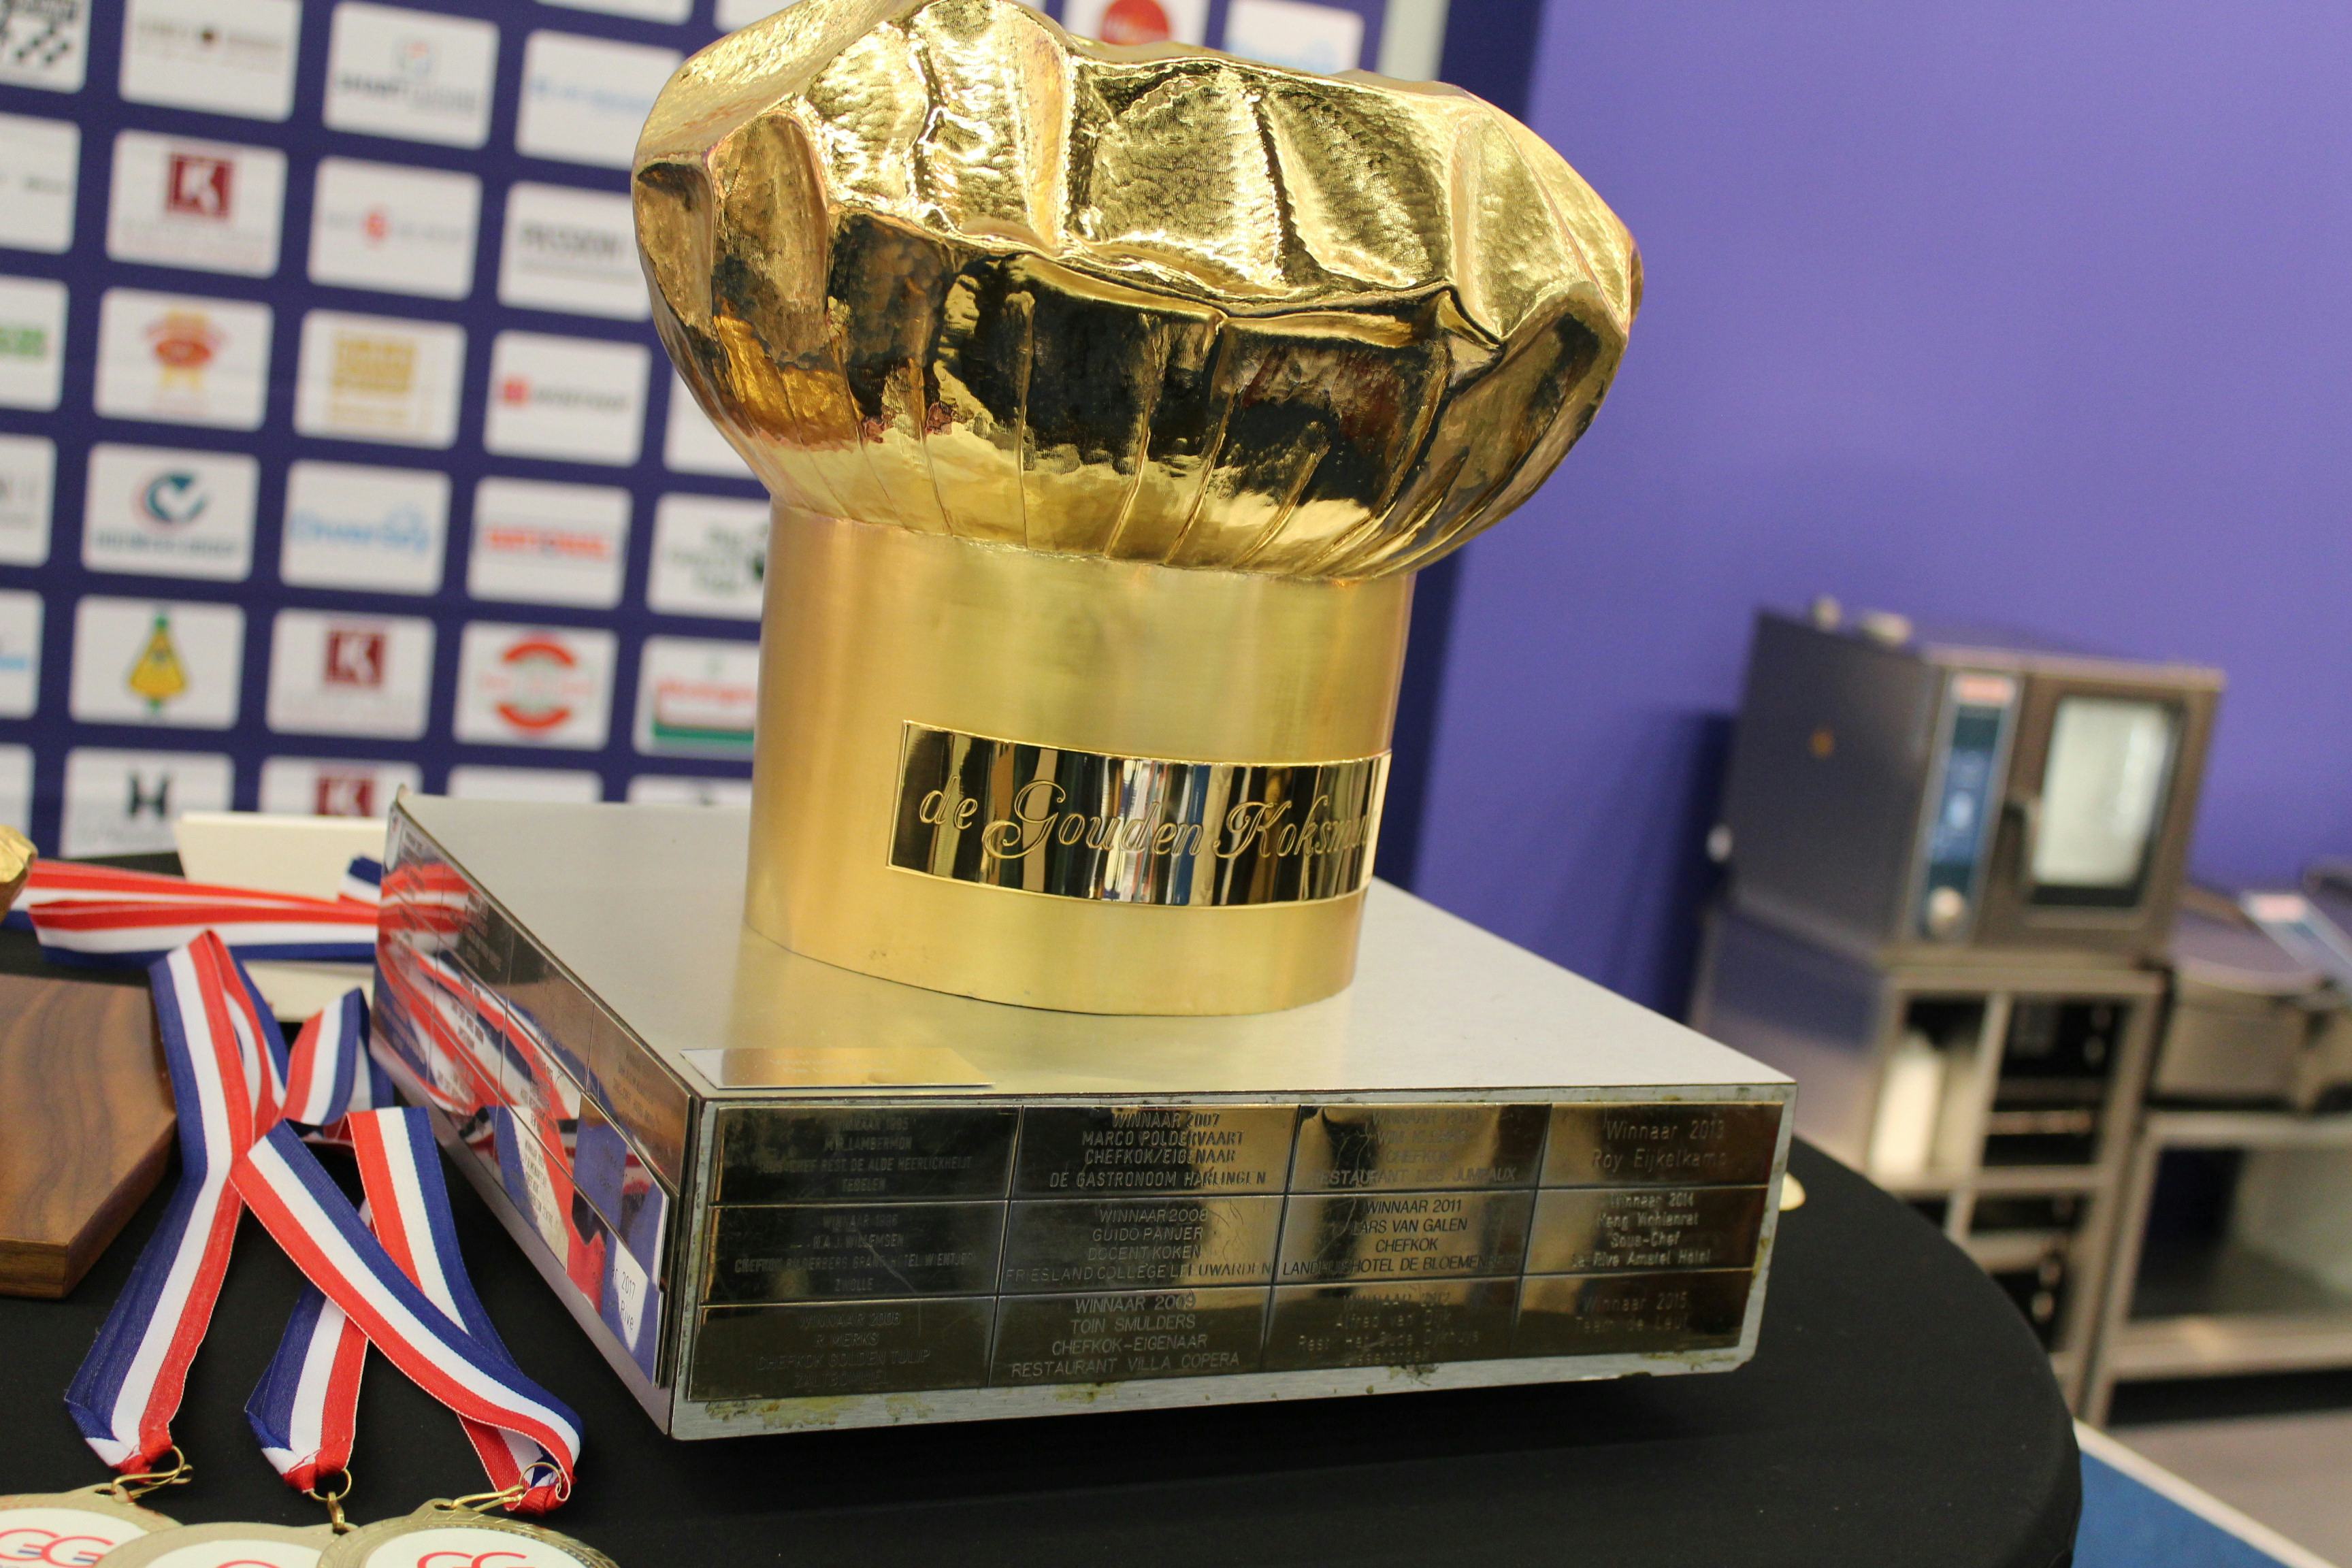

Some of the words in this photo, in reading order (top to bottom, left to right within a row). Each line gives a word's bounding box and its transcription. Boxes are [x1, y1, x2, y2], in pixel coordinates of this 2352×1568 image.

[919, 775, 978, 830] de
[982, 779, 1203, 860] Gouden
[1111, 1112, 1181, 1128] WINNAAR
[1186, 1113, 1220, 1127] 2007
[1082, 1130, 1134, 1146] MARCO
[1139, 1130, 1245, 1146] POLDERVAART
[1605, 1121, 1678, 1140] Winnaar
[1689, 1120, 1725, 1141] 2013
[1085, 1148, 1236, 1164] CHEFKOK/EIGENAAR
[1592, 1148, 1623, 1173] Roy
[1049, 1172, 1068, 1188] DE
[1076, 1171, 1177, 1188] GASTRONOOM
[1099, 1207, 1167, 1223] WINNAAR
[1169, 1207, 1208, 1222] 2008
[1363, 1198, 1428, 1215] WINNAAR
[1433, 1198, 1462, 1213] 2011
[1092, 1228, 1139, 1243] GUIDO
[1143, 1226, 1203, 1242] PANJER
[1351, 1220, 1388, 1235] LARS
[1392, 1219, 1419, 1233] VAN
[1423, 1218, 1468, 1232] GALEN
[1088, 1245, 1146, 1261] DOCENT
[1152, 1245, 1203, 1260] KOKEN
[1375, 1237, 1439, 1253] CHEFKOK
[1005, 1266, 1093, 1283] FRIESLAND
[1097, 1263, 1164, 1279] COLLEGE
[1282, 1256, 1395, 1276] LANDHUISHOTEL
[1399, 1256, 1418, 1272] DE
[621, 1271, 636, 1301] 2017
[1075, 1295, 1145, 1314] WINNAAR
[620, 1301, 634, 1330] Rive
[1071, 1318, 1105, 1335] TOIN
[1114, 1313, 1196, 1331] SMULDERS
[1011, 1359, 1117, 1379] RESTAURANT
[1127, 1356, 1171, 1373] VILLA
[1181, 1352, 1240, 1369] COPERA
